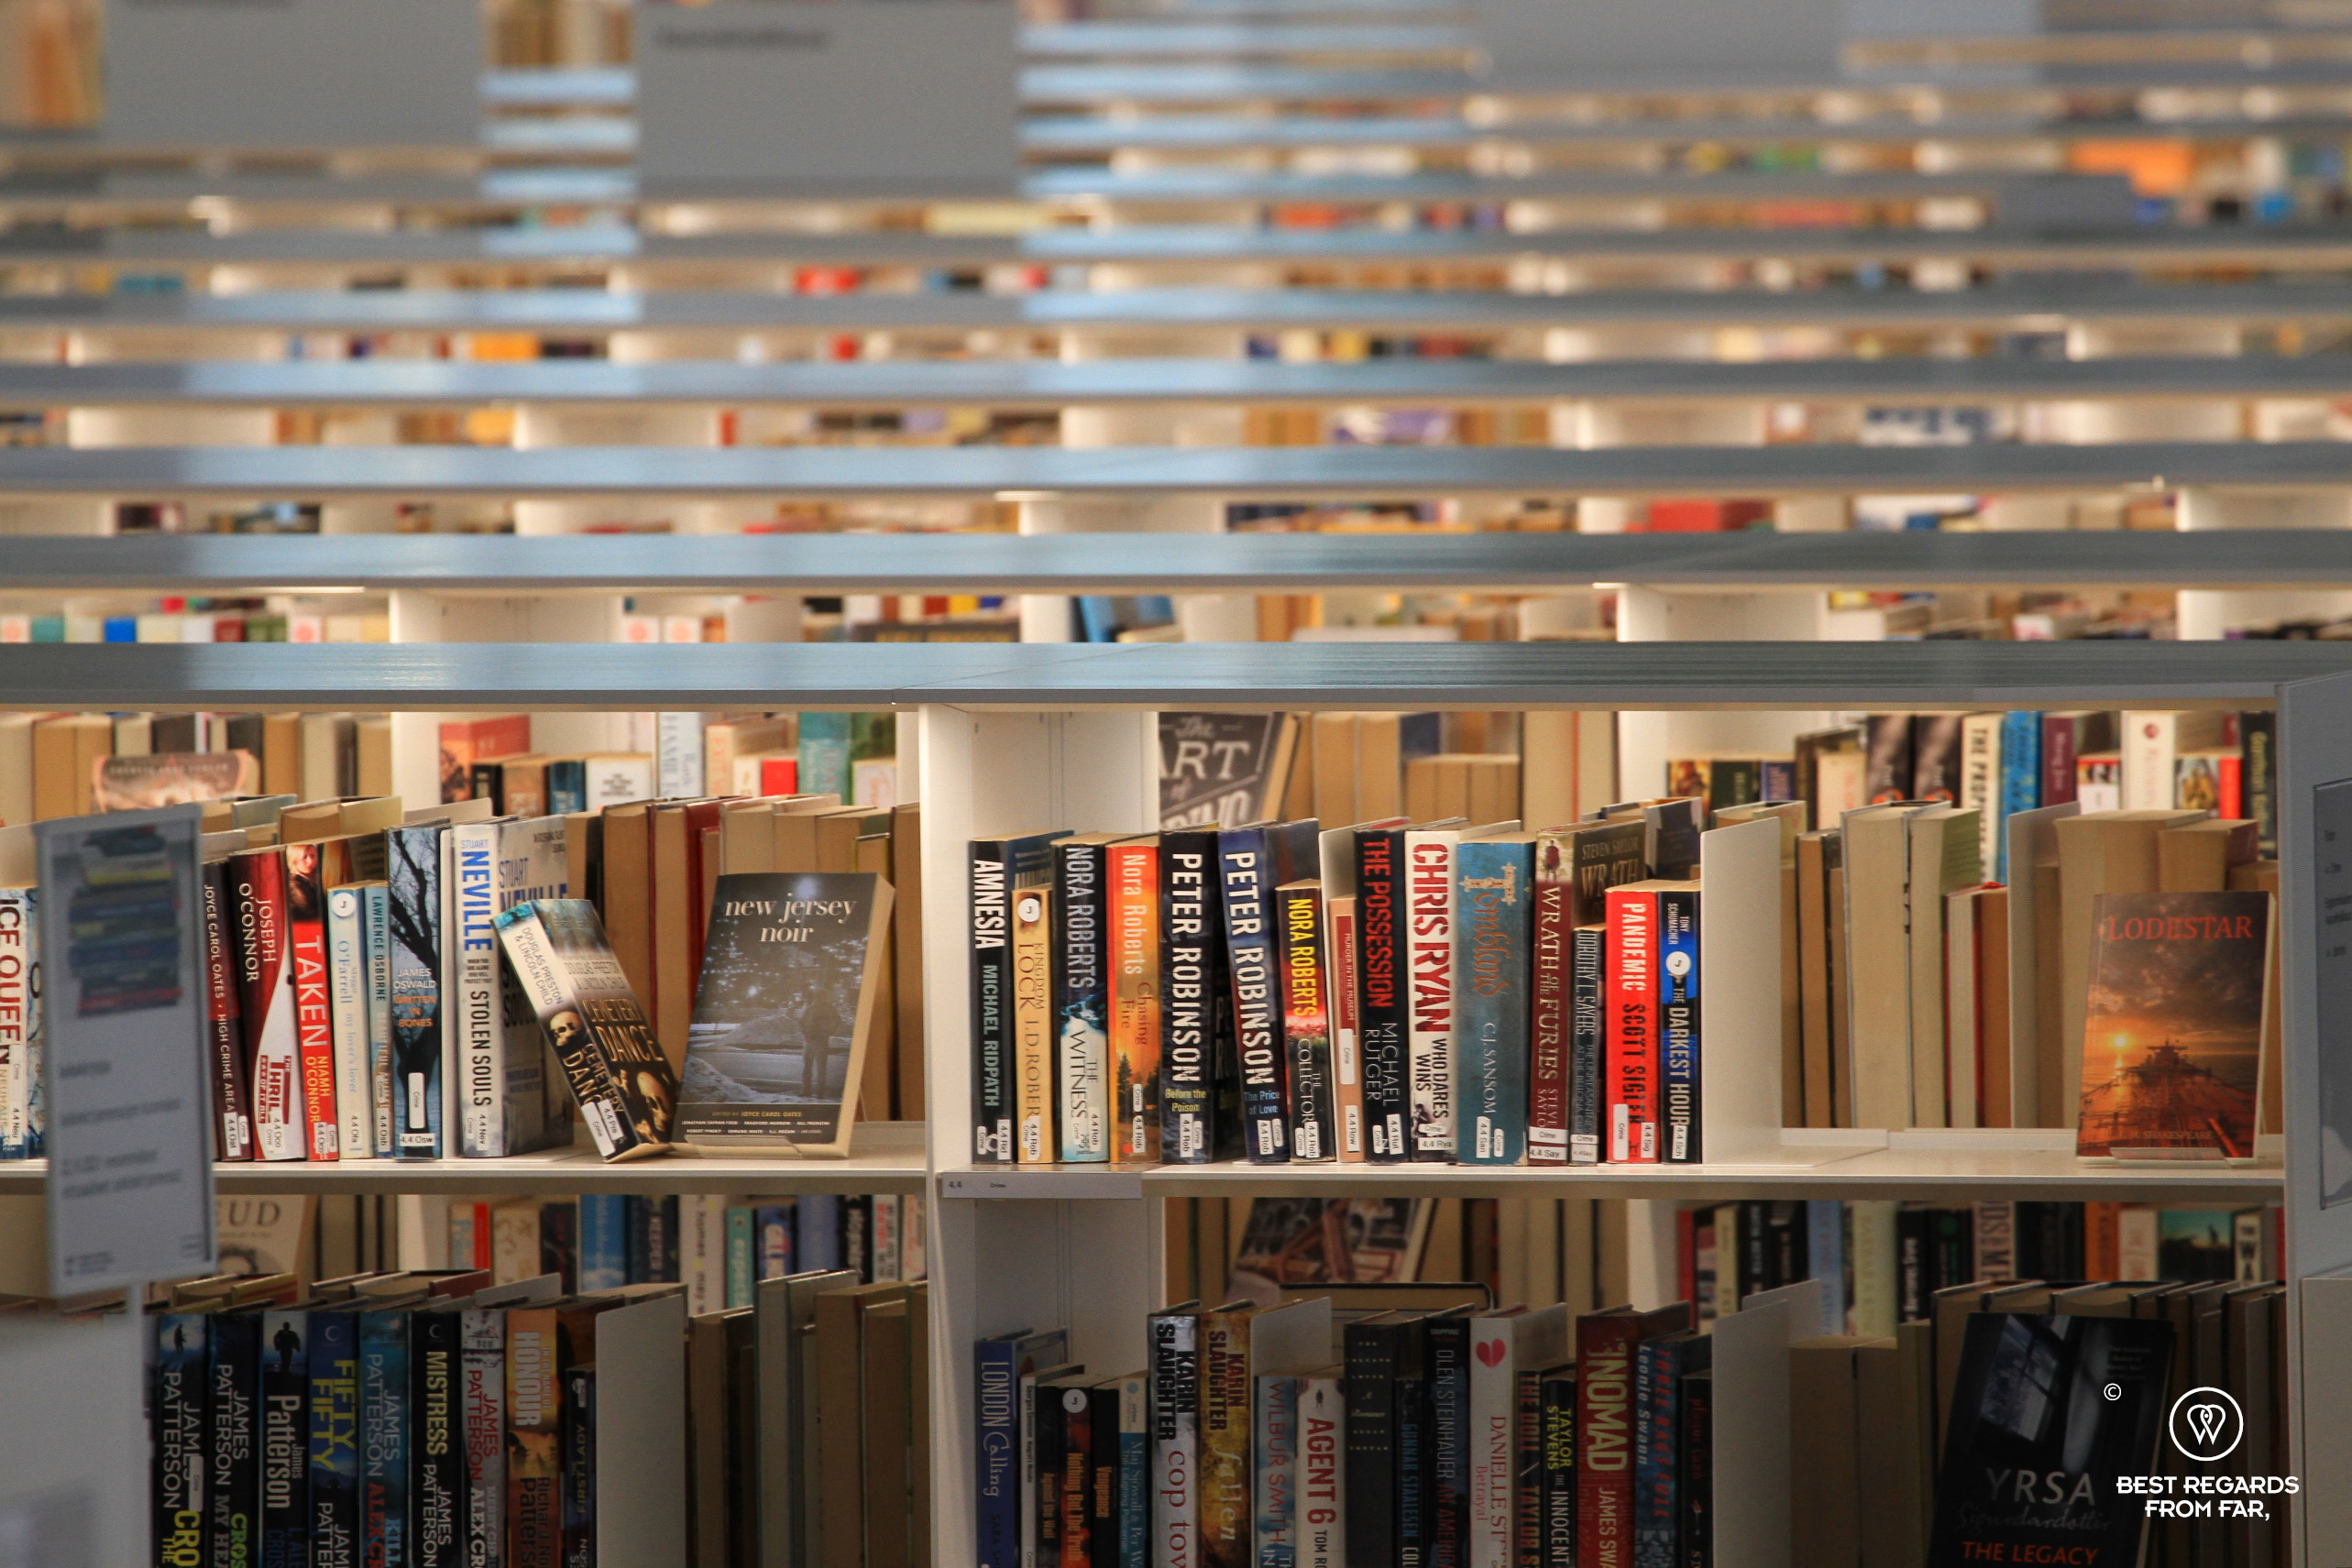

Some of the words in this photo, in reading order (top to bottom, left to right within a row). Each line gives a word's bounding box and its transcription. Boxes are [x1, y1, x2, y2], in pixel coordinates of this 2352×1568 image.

[461, 839, 489, 849] STUART
[1363, 838, 1390, 877] THE
[1065, 847, 1097, 898] NORA
[1122, 854, 1148, 895] Nora
[1172, 854, 1203, 935] PETER
[1225, 852, 1261, 936] PETER
[1413, 843, 1450, 937] CHRIS
[203, 884, 215, 920] JOYCE
[372, 895, 383, 950] LAWRENCE
[461, 851, 492, 952] NEVILLE
[725, 900, 777, 916] new
[778, 893, 857, 924] jersey
[973, 859, 1006, 949] AMNESIA
[1288, 898, 1315, 941] NORA
[1458, 861, 1518, 997] Tombland
[1540, 886, 1562, 970] WRATH
[1667, 903, 1678, 946] SCHUMACHER
[1678, 916, 1690, 933] TONY
[2108, 916, 2254, 941] LODESTAR
[208, 923, 221, 960] CAROL
[238, 883, 259, 982] O'CONNOR
[255, 898, 277, 962] JOSEPH
[759, 919, 815, 943] noir
[1066, 904, 1097, 989] ROBERTS
[1123, 904, 1149, 975] Roberts
[1344, 933, 1353, 962] MURDER
[1366, 881, 1394, 1007] POSSESSION
[1576, 932, 1596, 980] DOROTHY
[1617, 903, 1647, 992] PANDEMIC
[212, 964, 224, 998] OATES
[295, 935, 328, 1047] TAKEN
[338, 940, 353, 1003] O'Farrell
[374, 955, 386, 1002] OSBORNE
[393, 979, 436, 990] OSWALD
[397, 968, 432, 977] JAMES
[518, 942, 541, 980] LINCOLN
[535, 978, 553, 1005] CHILD
[522, 927, 544, 967] DOUGLAS
[541, 966, 564, 1005] PRESTON
[1017, 944, 1036, 1013] LOCK
[1034, 942, 1045, 1010] KINGDOM
[1291, 946, 1318, 1017] ROBERTS
[1345, 963, 1354, 971] IN
[1346, 973, 1354, 989] THE
[1413, 942, 1451, 1032] RYAN
[1540, 972, 1550, 995] THE
[1550, 976, 1559, 992] OF
[1577, 983, 1596, 992] L.
[345, 1013, 354, 1029] my
[394, 995, 436, 1005] WRITTEN
[399, 1018, 434, 1027] BONES
[410, 1008, 422, 1016] IN
[470, 990, 490, 1050] STOLEN
[983, 965, 998, 1035] MICHAEL
[1120, 1000, 1135, 1029] Fire
[1135, 982, 1152, 1046] Chasing
[1171, 947, 1203, 1082] ROBINSON
[1234, 947, 1275, 1086] ROBINSON
[1346, 990, 1355, 1021] MUSEUM
[1576, 996, 1596, 1036] SAYERS
[1673, 987, 1685, 1003] THE
[216, 1014, 228, 1041] HIGH
[346, 1032, 357, 1065] lover's
[595, 1025, 665, 1062] DANCE
[1432, 1038, 1447, 1071] WHO
[1482, 1023, 1498, 1047] C.J.
[1538, 998, 1559, 1080] FURIES
[1622, 1003, 1646, 1058] SCOTT
[1668, 1006, 1691, 1080] DARKEST
[220, 1045, 233, 1079] CRIME
[305, 1056, 321, 1123] O'CONNOR
[317, 1056, 330, 1097] NIAMH
[348, 1068, 358, 1093] lover
[472, 1055, 492, 1107] SOULS
[984, 1040, 1000, 1107] RIDPATH
[1068, 1030, 1087, 1119] WITNESS
[1086, 1058, 1099, 1084] THE
[1297, 1037, 1315, 1124] COLLECTOR
[1364, 1029, 1381, 1102] RUTGER
[1381, 1022, 1400, 1106] MICHAEL
[1415, 1054, 1432, 1091] WINS
[1483, 1048, 1498, 1114] SANSOM
[225, 1083, 236, 1112] AREA
[1165, 1089, 1192, 1100] Before
[1193, 1089, 1207, 1099] the
[1171, 1102, 1200, 1113] Poison
[1258, 1103, 1279, 1113] Love
[1433, 1073, 1448, 1119] DARES
[1669, 1083, 1691, 1126] HOUR
[400, 1135, 413, 1144] 4.4
[414, 1135, 434, 1145] Osw
[1182, 1120, 1191, 1134] 4.4
[1182, 1135, 1191, 1152] Rob
[1479, 1123, 1488, 1135] 4.4
[1479, 1136, 1488, 1153] San
[948, 1180, 962, 1189] 4.4
[514, 1332, 542, 1427] HONOUR
[981, 1362, 1011, 1427] LONDON
[1156, 1323, 1177, 1442] SLAUGHTER
[1176, 1351, 1195, 1415] KARIN
[1208, 1330, 1227, 1431] SLAUGHTER
[1227, 1353, 1246, 1408] KARIN
[1436, 1350, 1455, 1386] OLEN
[1519, 1375, 1540, 1406] THE
[1638, 1344, 1651, 1402] Leonie
[1654, 1349, 1672, 1409] THREE
[214, 1364, 233, 1486] PATTERSON
[232, 1390, 250, 1460] JAMES
[312, 1378, 335, 1470] FIFTY
[334, 1360, 356, 1451] FIFTY
[367, 1354, 384, 1477] PATTERSON
[384, 1389, 401, 1461] JAMES
[426, 1351, 448, 1456] MISTRESS
[467, 1370, 483, 1481] PATTERSON
[483, 1393, 499, 1458] JAMES
[1268, 1381, 1287, 1469] WILBUR
[1587, 1358, 1628, 1471] NOMAD
[163, 1372, 181, 1508] PATTERSON
[266, 1395, 301, 1508] Patterson
[291, 1443, 305, 1479] James
[1306, 1418, 1336, 1502] AGENT
[1401, 1423, 1418, 1471] GUNNAR
[1436, 1390, 1456, 1479] STEINHAUER
[1546, 1405, 1560, 1471] STEVENS
[1559, 1409, 1573, 1468] TAYLOR
[1638, 1410, 1651, 1465] Swann
[1654, 1416, 1671, 1466] BAGS
[983, 1431, 1011, 1498] Calling
[1063, 1453, 1083, 1492] Nothing
[1160, 1450, 1186, 1508] cop
[1490, 1416, 1507, 1510] DANIELLE
[1986, 1468, 2096, 1507] YRSA
[368, 1484, 385, 1540] ALEX
[423, 1464, 438, 1568] PATTERSON
[437, 1486, 453, 1546] JAMES
[470, 1487, 486, 1537] ALEX
[1067, 1494, 1083, 1511] But
[1094, 1466, 1112, 1518] Vengeance
[1212, 1445, 1242, 1541] fallen
[1268, 1474, 1287, 1543] SMITH
[1306, 1509, 1336, 1525] 6
[1401, 1475, 1419, 1538] STAALESEN
[1473, 1465, 1489, 1522] Betrayal
[1520, 1486, 1540, 1550] TAYLOR
[1599, 1486, 1617, 1536] JAMES
[1654, 1472, 1671, 1518] FULL
[1067, 1514, 1083, 1531] The
[1313, 1530, 1327, 1553] TOM
[1550, 1490, 1569, 1565] INNOCENT
[1962, 1541, 2005, 1562] THE
[2013, 1544, 2099, 1566] LEGACY
